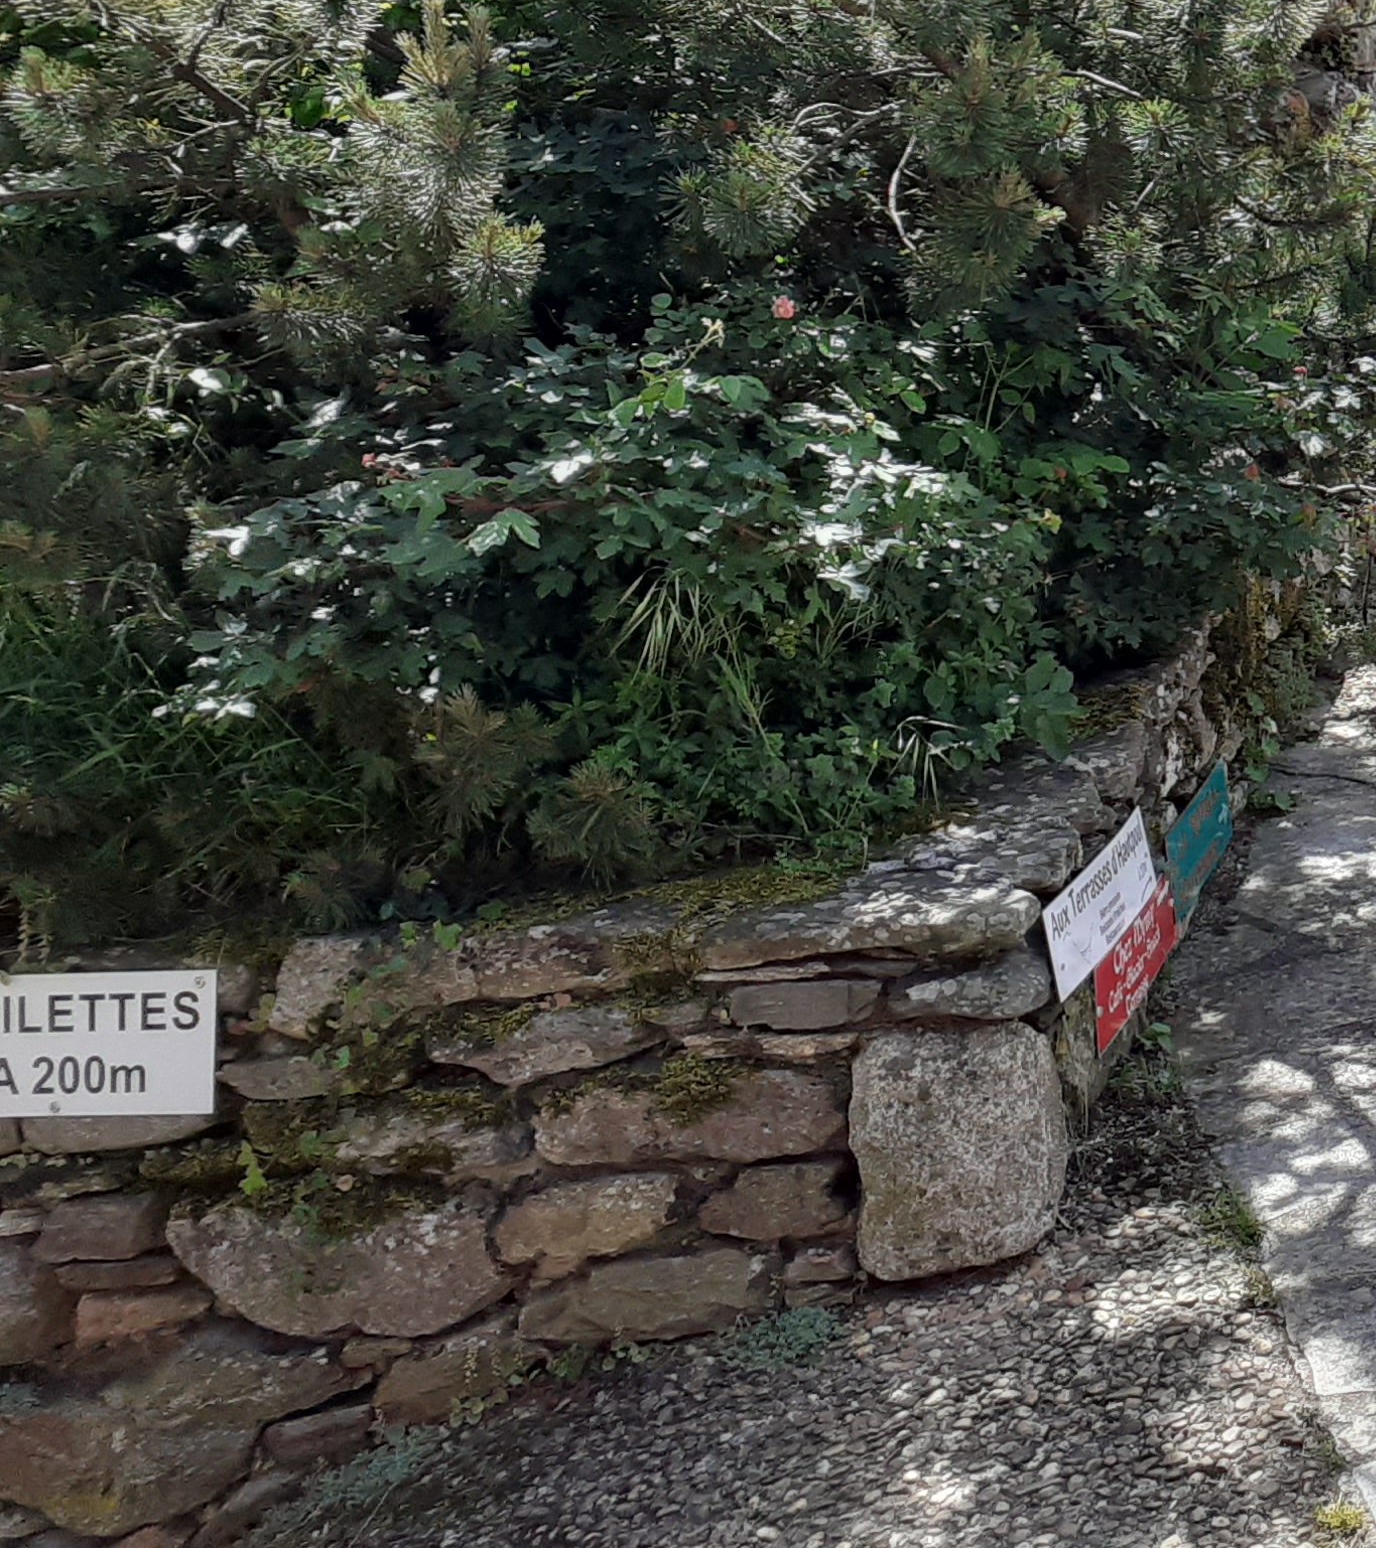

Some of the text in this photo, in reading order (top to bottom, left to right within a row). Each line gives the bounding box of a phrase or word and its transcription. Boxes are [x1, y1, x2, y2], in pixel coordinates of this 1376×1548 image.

[1050, 904, 1071, 942] Aux
[1067, 860, 1113, 917] Terrasses
[31, 1055, 147, 1095] 200m
